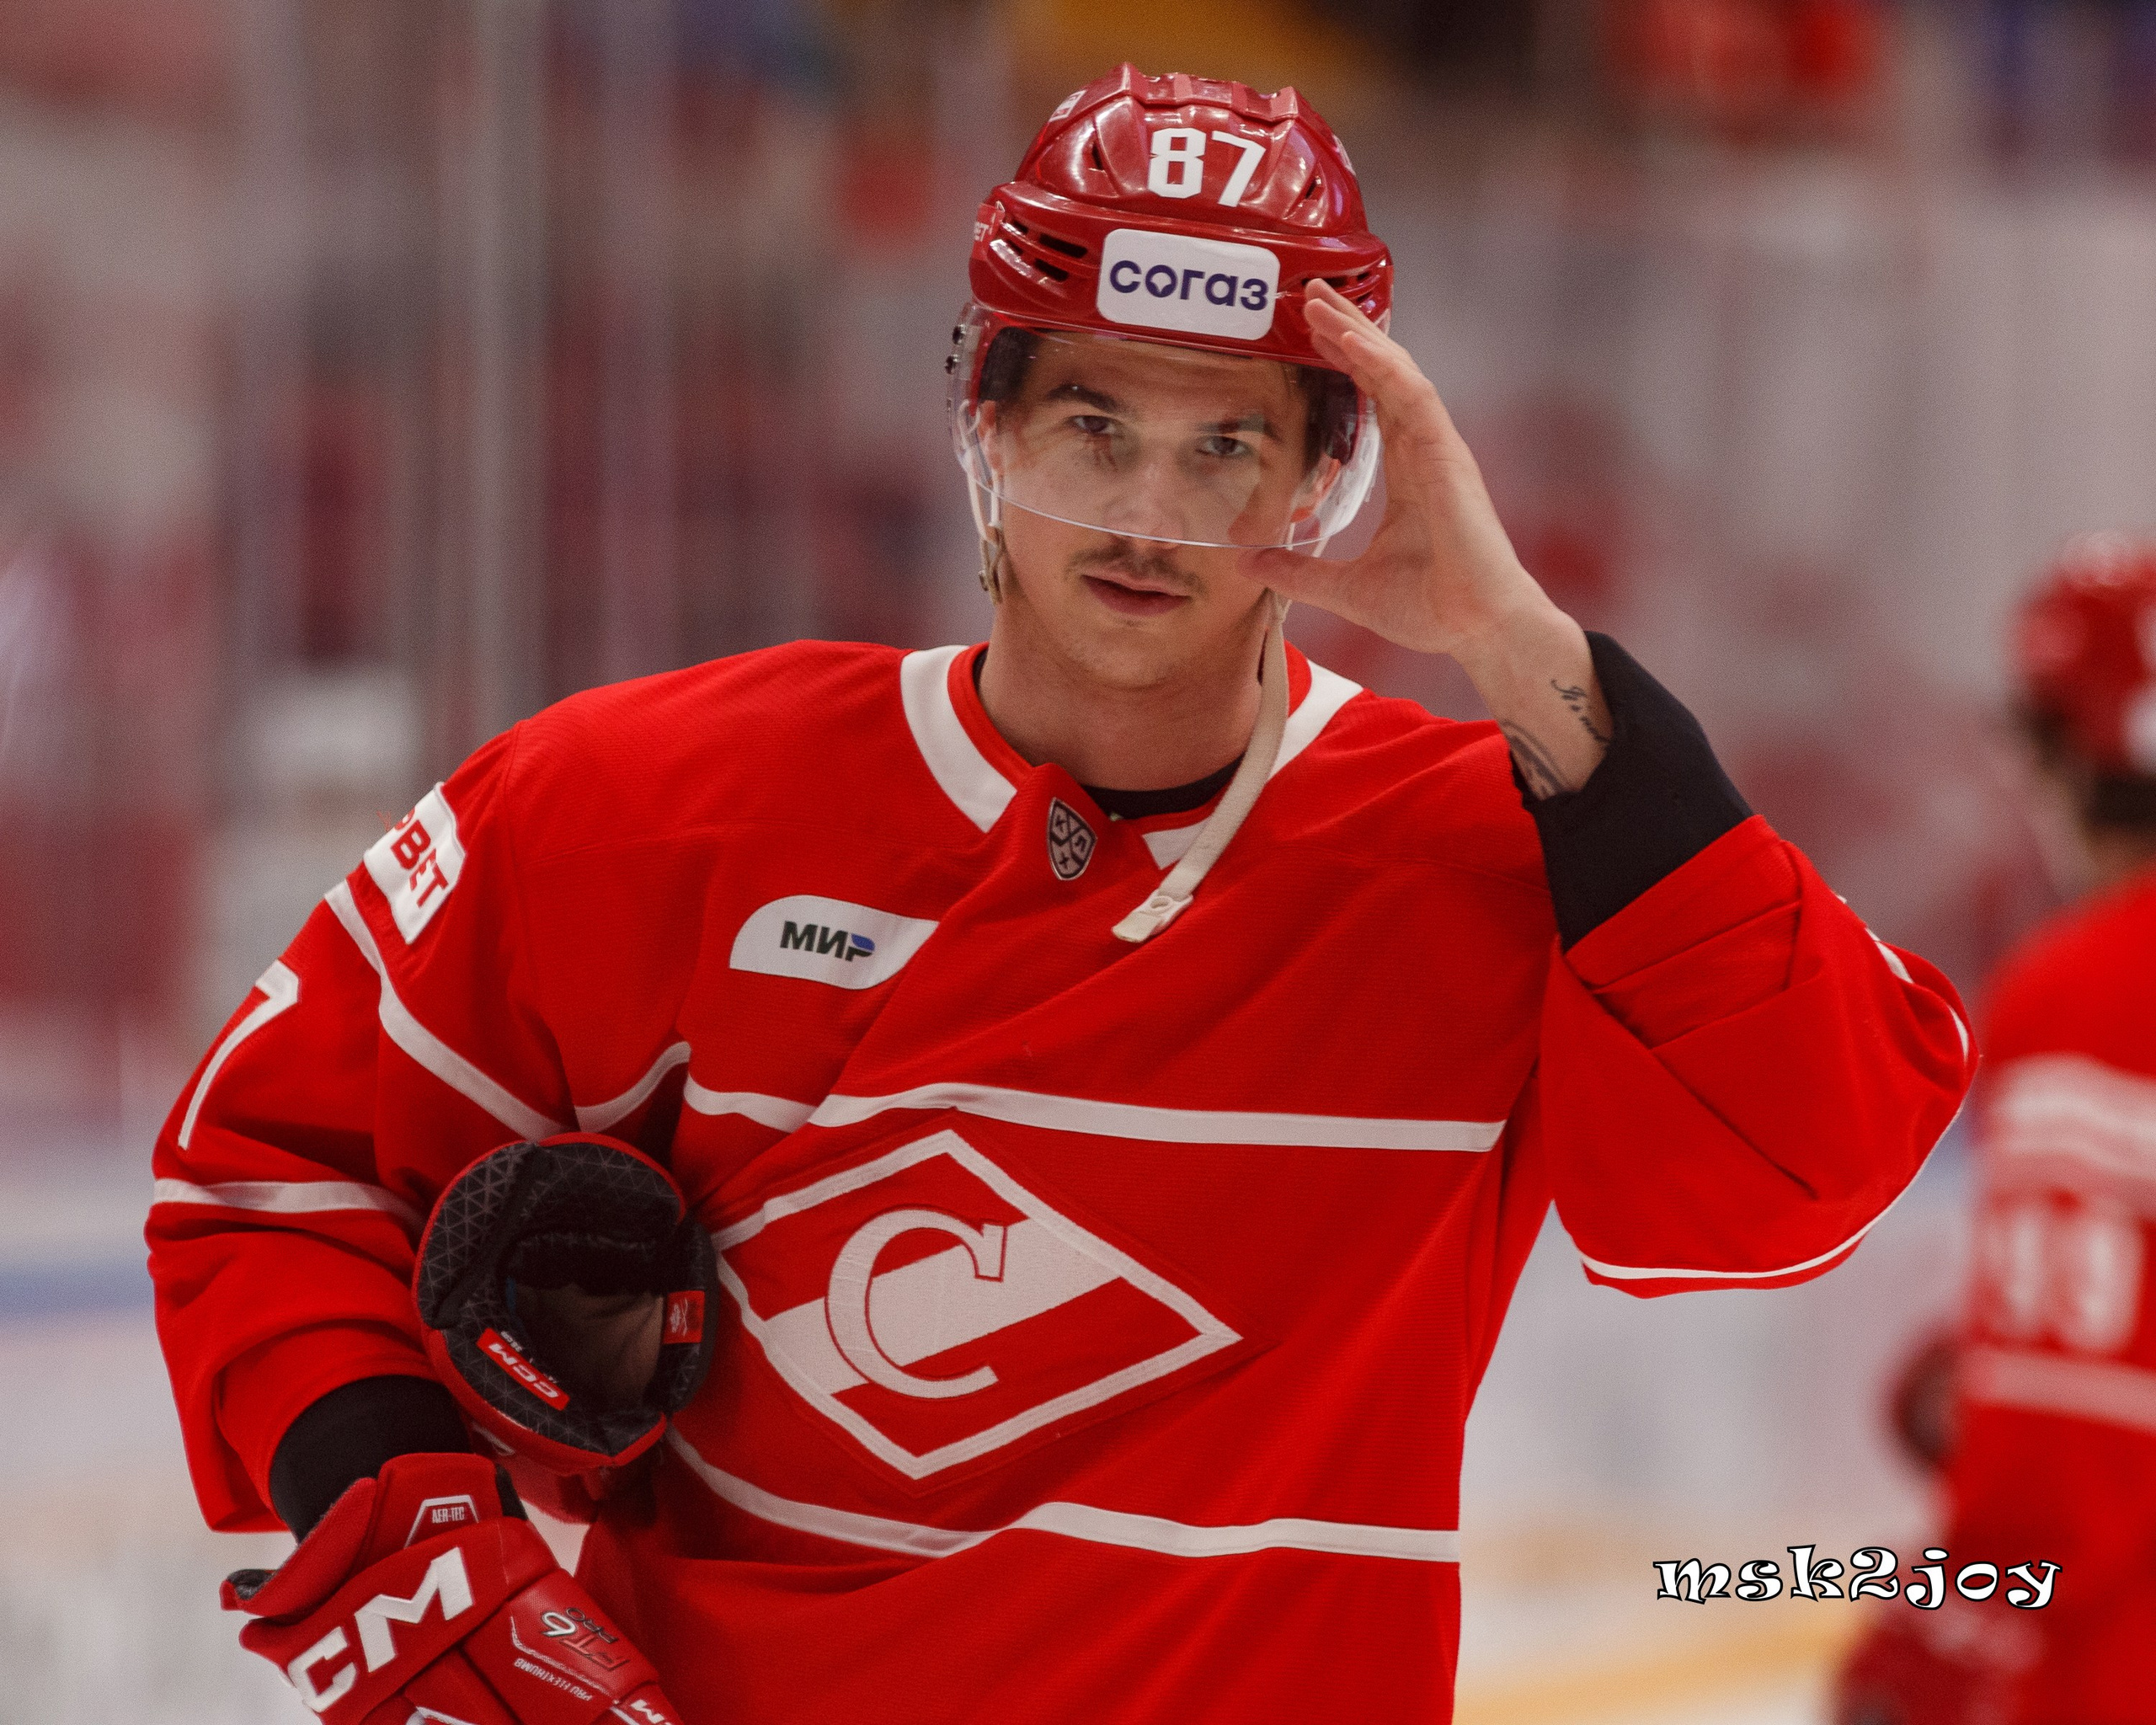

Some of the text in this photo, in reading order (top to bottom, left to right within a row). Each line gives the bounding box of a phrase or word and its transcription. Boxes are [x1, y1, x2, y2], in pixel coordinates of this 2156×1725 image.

[1149, 128, 1266, 207] 87
[1110, 259, 1268, 311] согаз
[780, 921, 875, 962] МИР
[178, 959, 299, 1151] 7
[488, 1343, 559, 1399] CCM
[432, 1507, 465, 1524] AER-TEC
[542, 1612, 630, 1671] FT6
